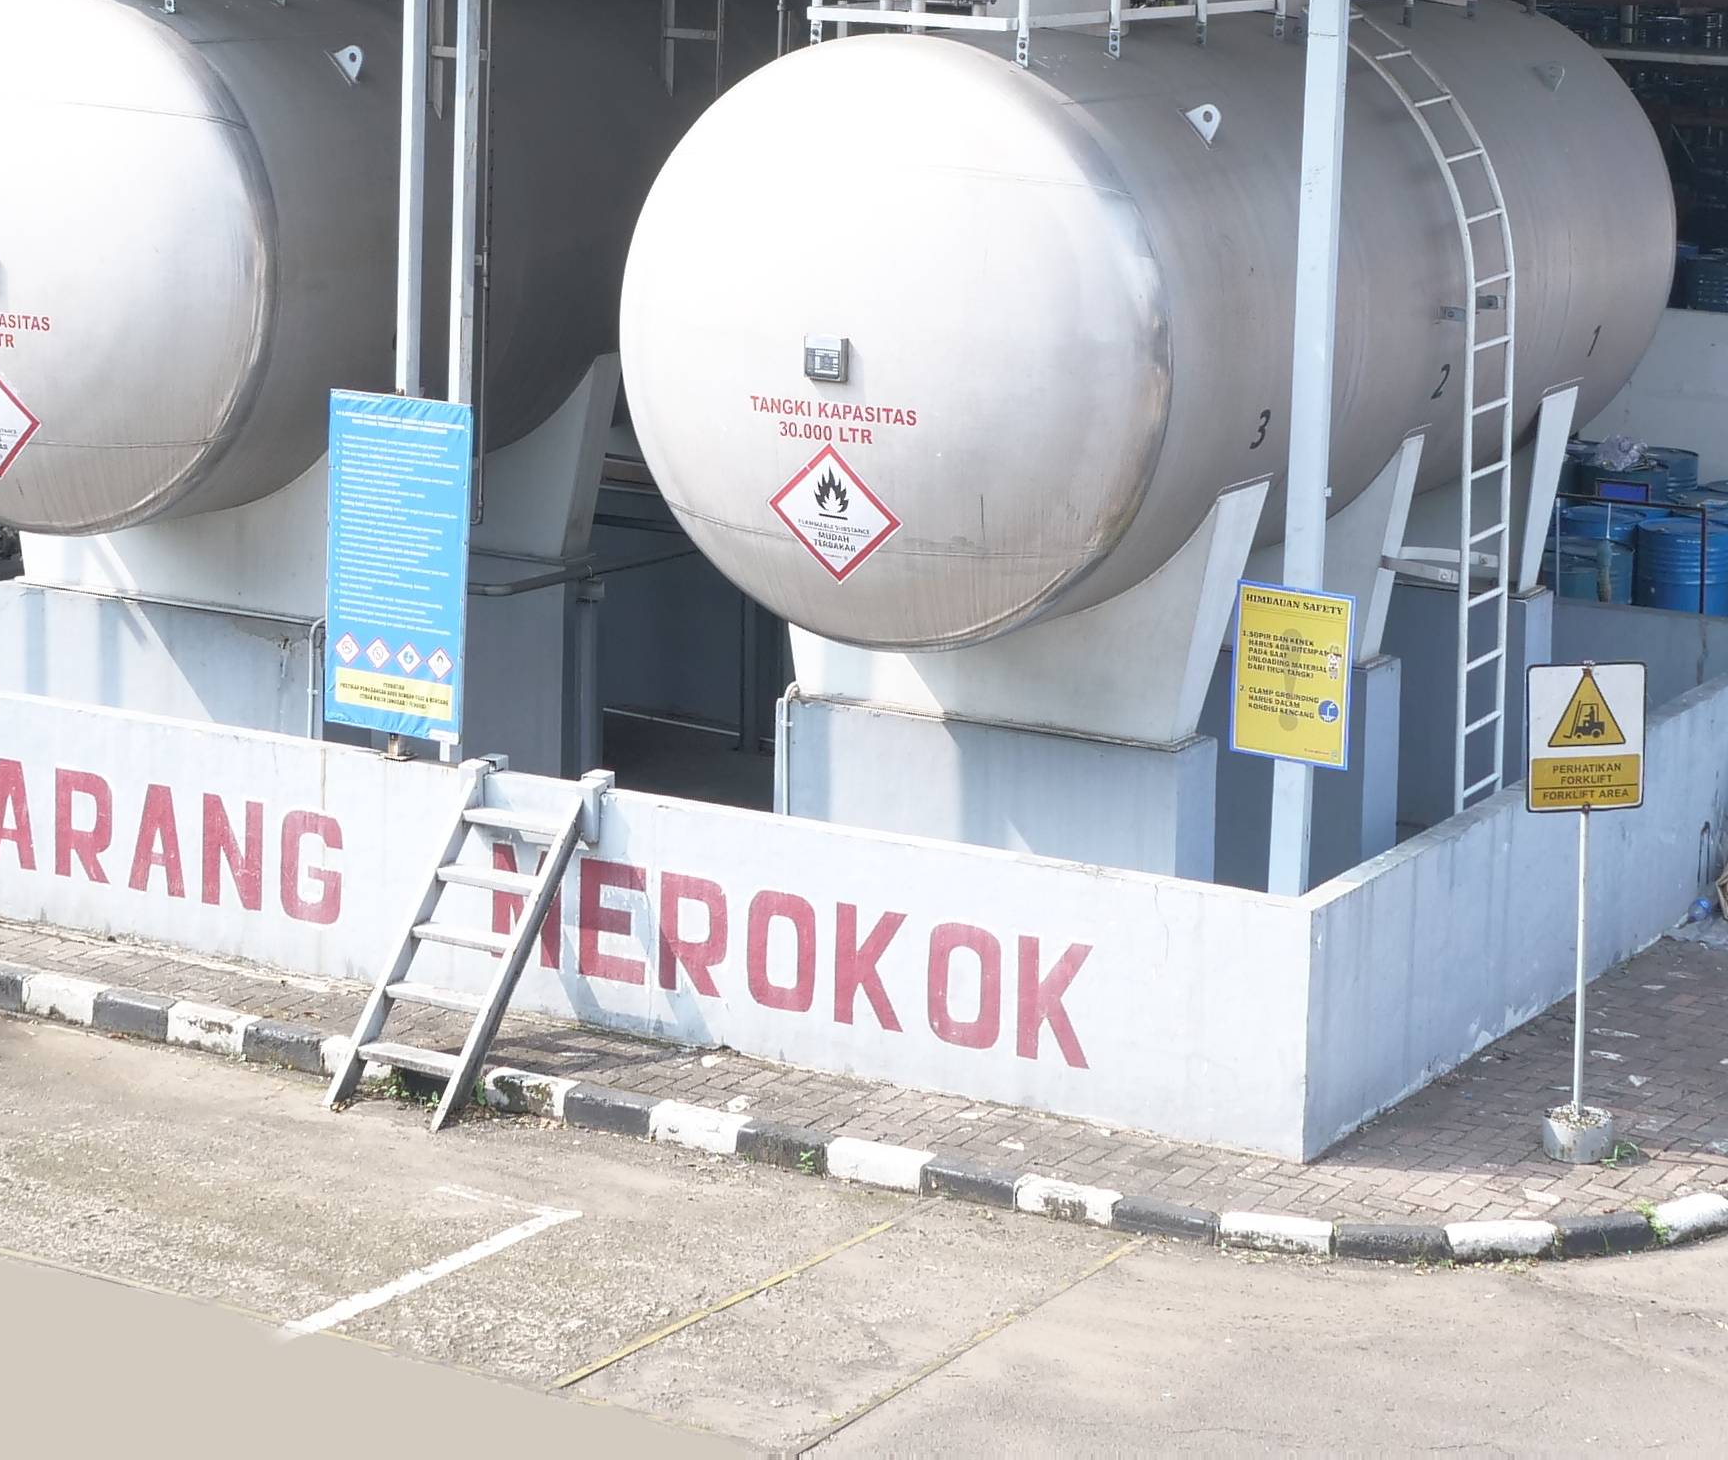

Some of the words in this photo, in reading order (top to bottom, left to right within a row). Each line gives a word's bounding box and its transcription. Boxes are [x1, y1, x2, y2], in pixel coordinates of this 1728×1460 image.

[1587, 325, 1602, 358] 1
[1430, 363, 1451, 400] 2
[750, 395, 812, 417] TANGKI
[818, 402, 917, 426] KAPASITAS
[778, 421, 833, 442] 30.000
[839, 427, 873, 445] LTR
[1249, 408, 1272, 450] 3
[813, 538, 856, 552] TERBAKAR
[818, 531, 850, 543] MUDAH
[1246, 593, 1301, 609] HIMBAUAN
[1303, 601, 1344, 615] SAFETY
[1552, 763, 1622, 774] PERHATIKAN
[1560, 774, 1613, 785] FORKLIFT
[1542, 789, 1595, 801] FORKLIFT
[1598, 787, 1630, 798] AREA
